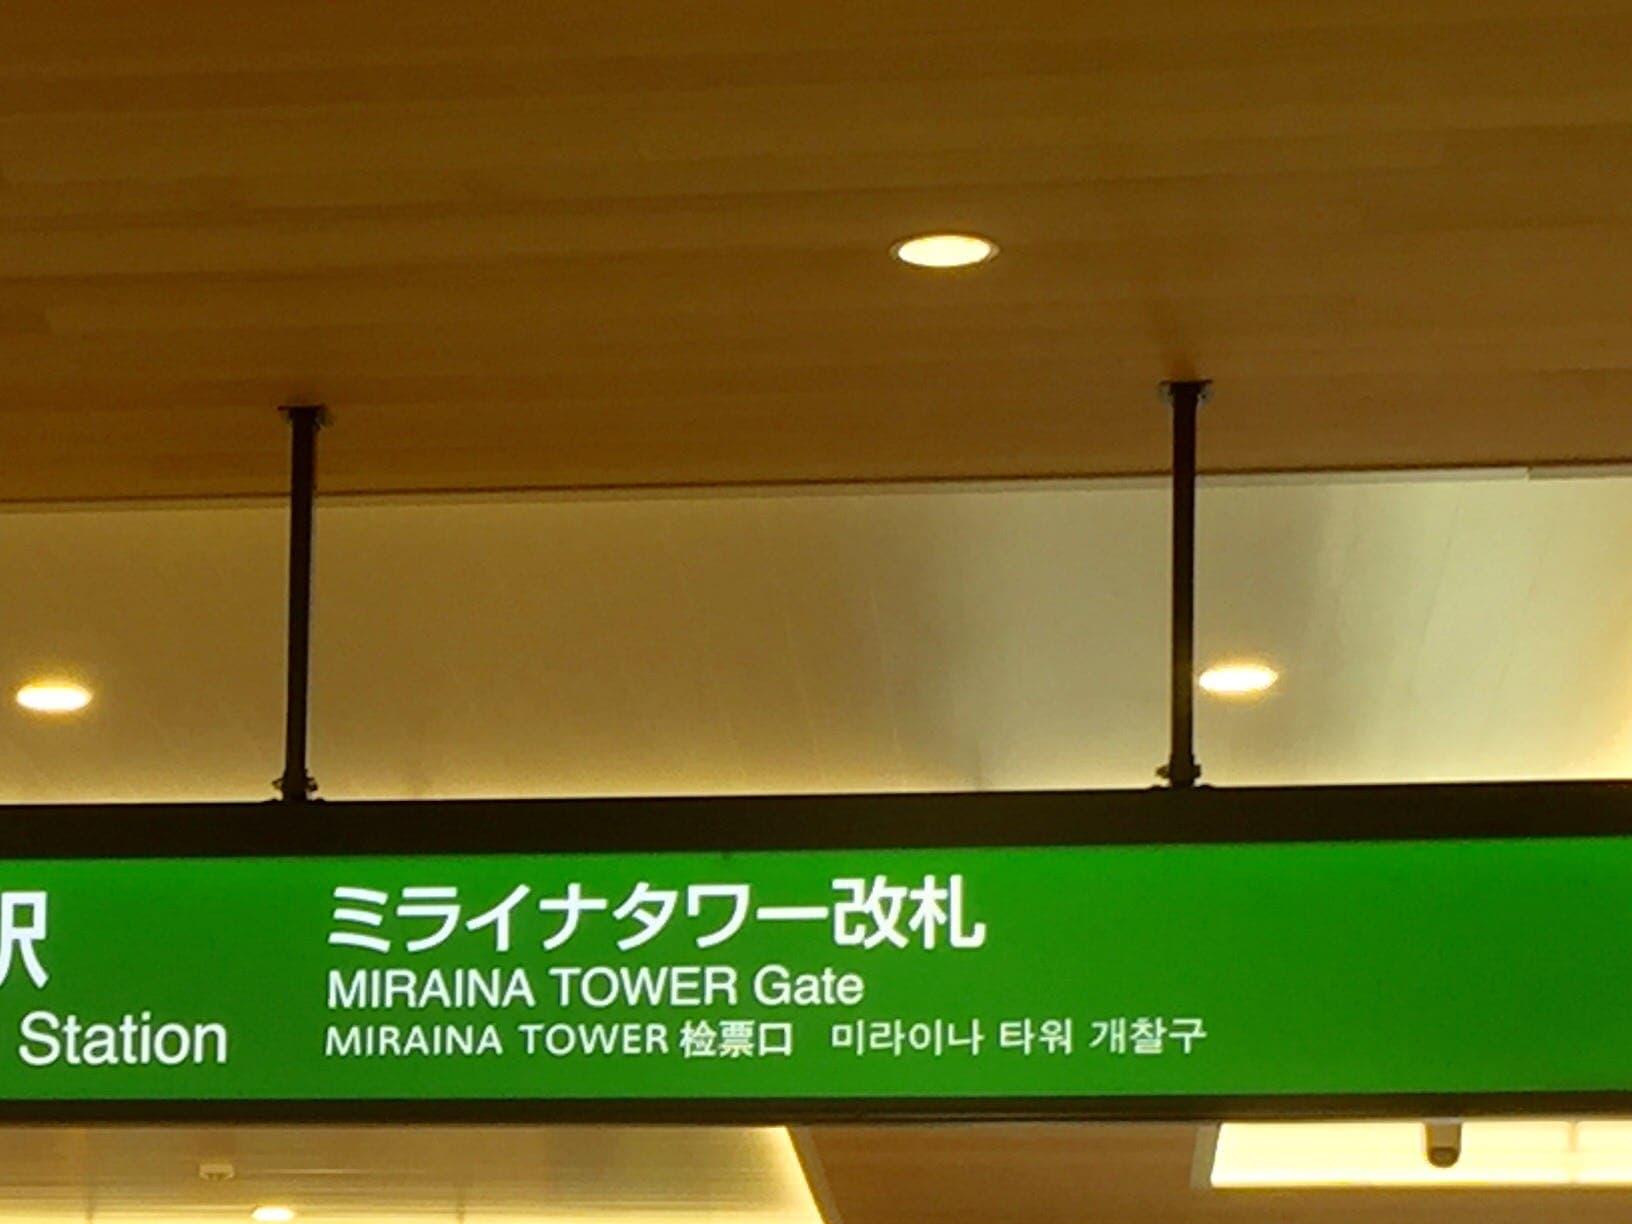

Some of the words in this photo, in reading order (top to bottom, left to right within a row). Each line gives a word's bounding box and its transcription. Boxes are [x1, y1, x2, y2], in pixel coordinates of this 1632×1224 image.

[327, 873, 986, 954] ミライナタワー改札
[326, 967, 536, 1009] MIRAINA
[550, 965, 740, 1008] TOWER
[754, 963, 865, 1007] Gate
[19, 1011, 227, 1067] Station
[325, 1023, 504, 1057] MIRAINA
[520, 1022, 669, 1056] TOWER
[680, 1019, 794, 1059] 检票口
[832, 1018, 985, 1057] 미라이나
[999, 1018, 1074, 1055] 타워
[1090, 1018, 1207, 1055] 개찰구
